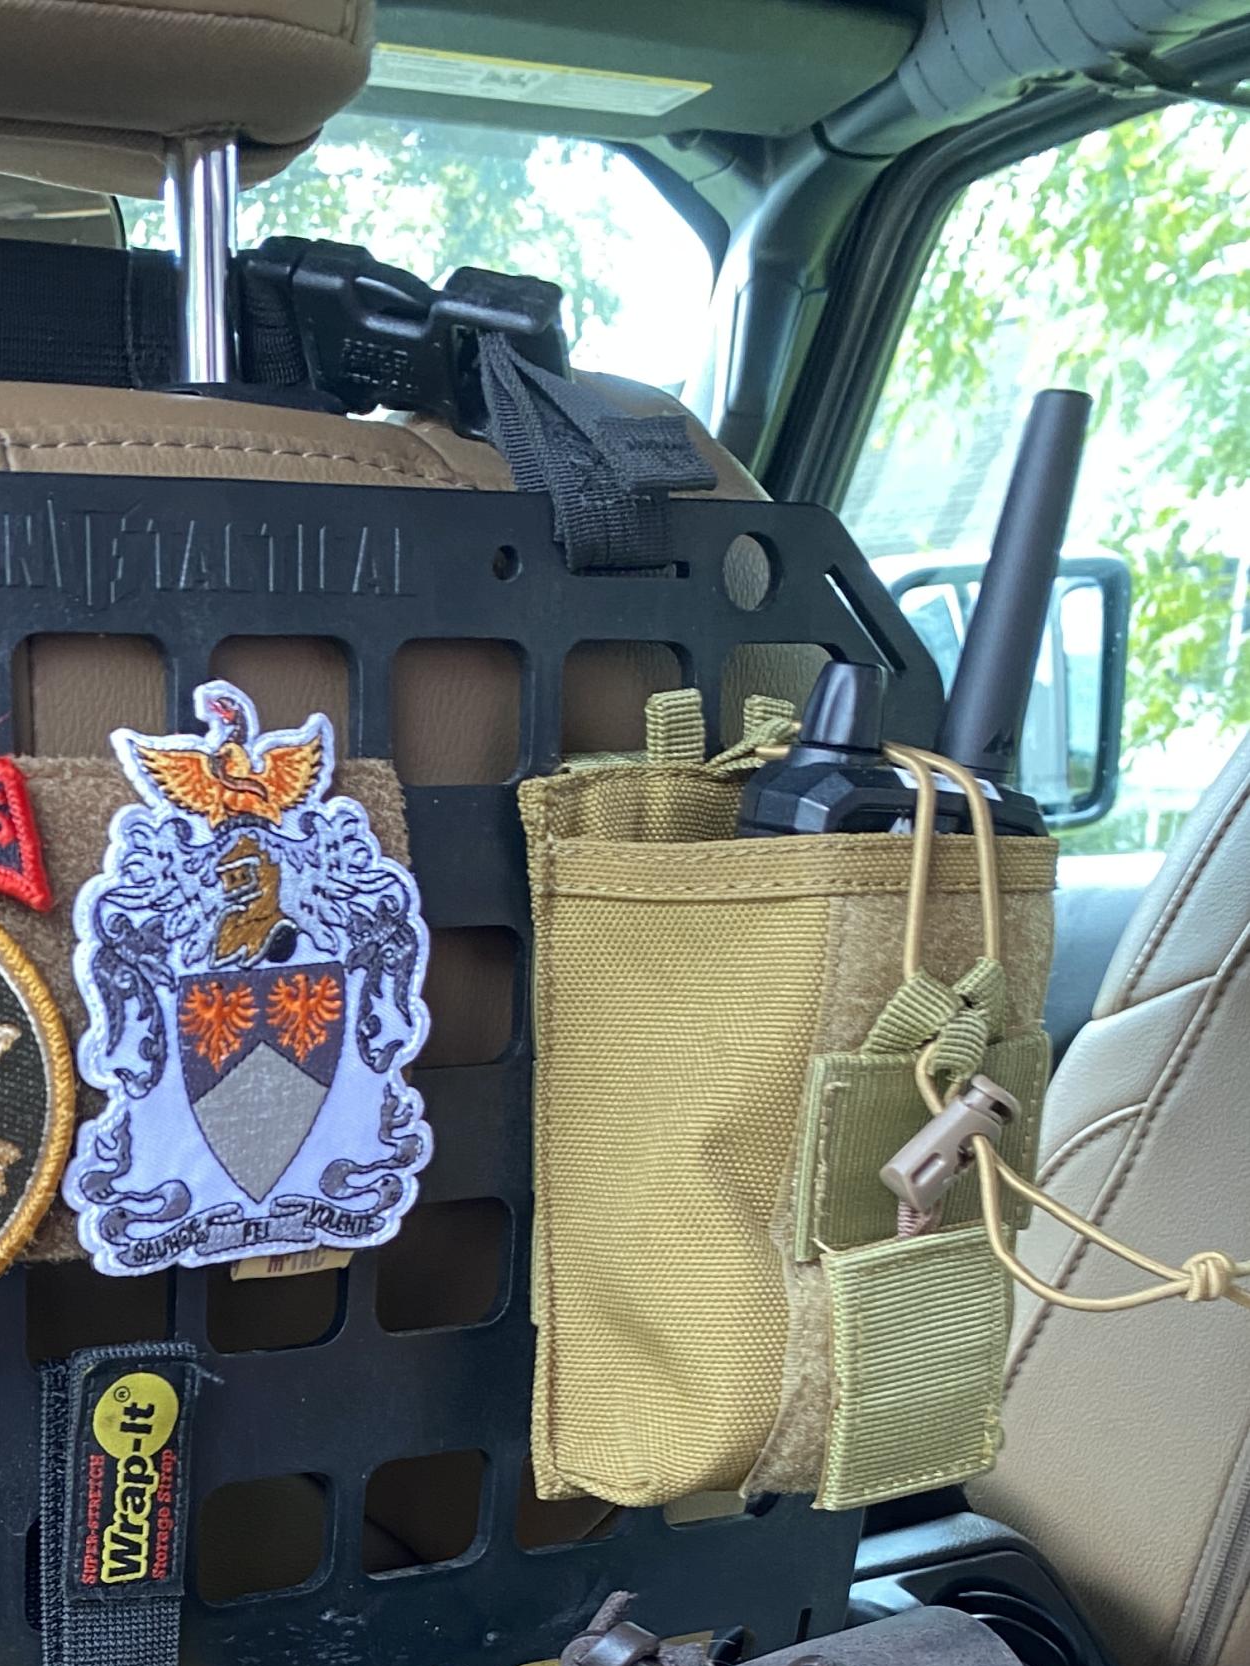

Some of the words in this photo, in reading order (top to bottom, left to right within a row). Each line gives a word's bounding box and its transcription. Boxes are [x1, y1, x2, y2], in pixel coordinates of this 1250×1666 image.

[81, 1454, 106, 1585] SUPER-STRETCH
[107, 1401, 155, 1579] Wrap-It
[157, 1449, 177, 1503] Strap
[152, 1506, 174, 1581] Storage
